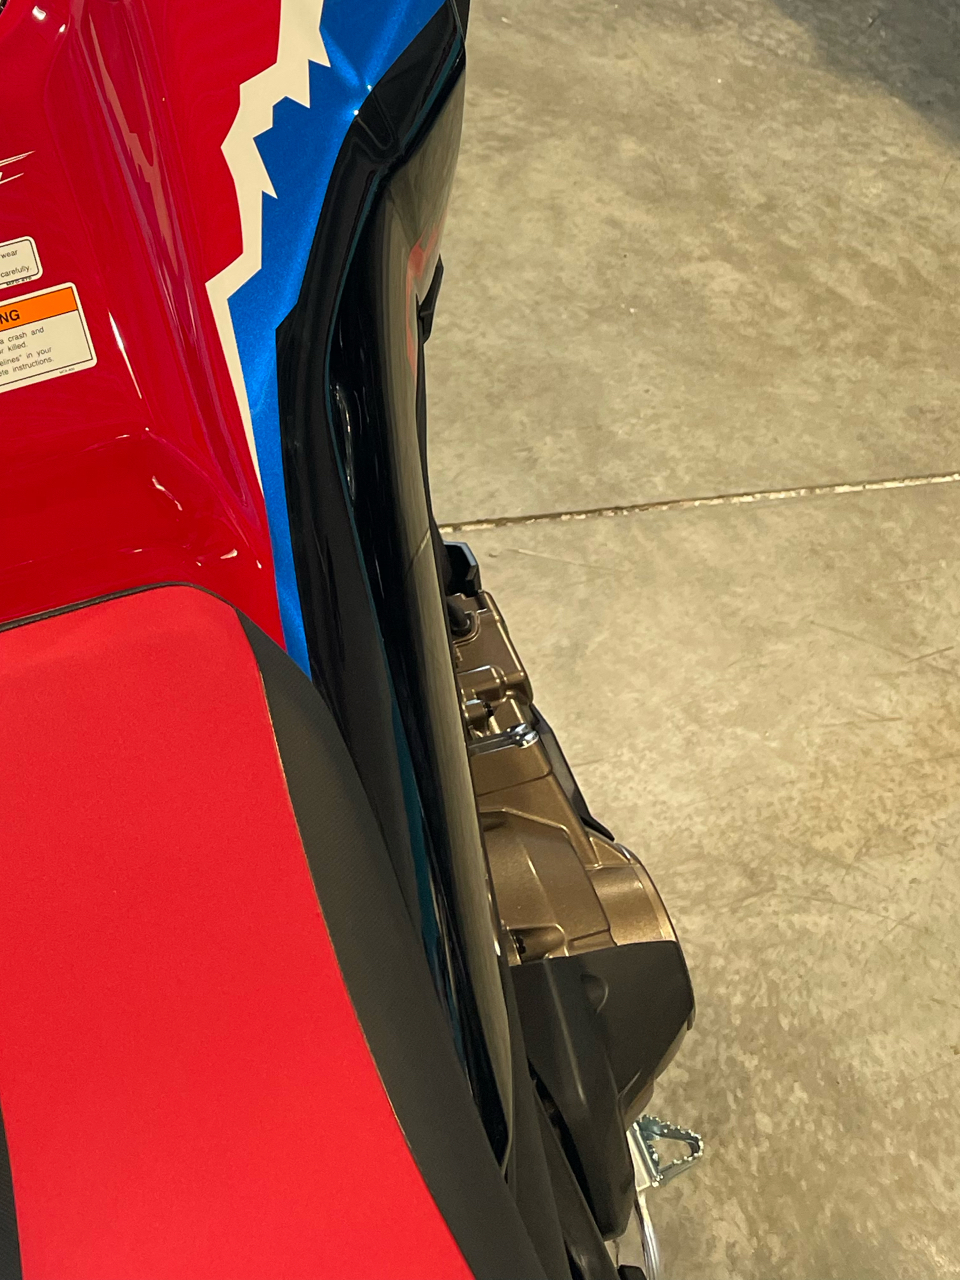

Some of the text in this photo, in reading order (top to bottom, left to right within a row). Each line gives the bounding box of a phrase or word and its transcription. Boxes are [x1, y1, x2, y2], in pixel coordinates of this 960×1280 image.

[0, 249, 18, 259] wear
[0, 265, 32, 278] carefully.
[7, 332, 27, 343] crash
[31, 326, 45, 336] and
[7, 341, 28, 352] killed.
[36, 346, 52, 357] your
[12, 356, 54, 372] instructions.
